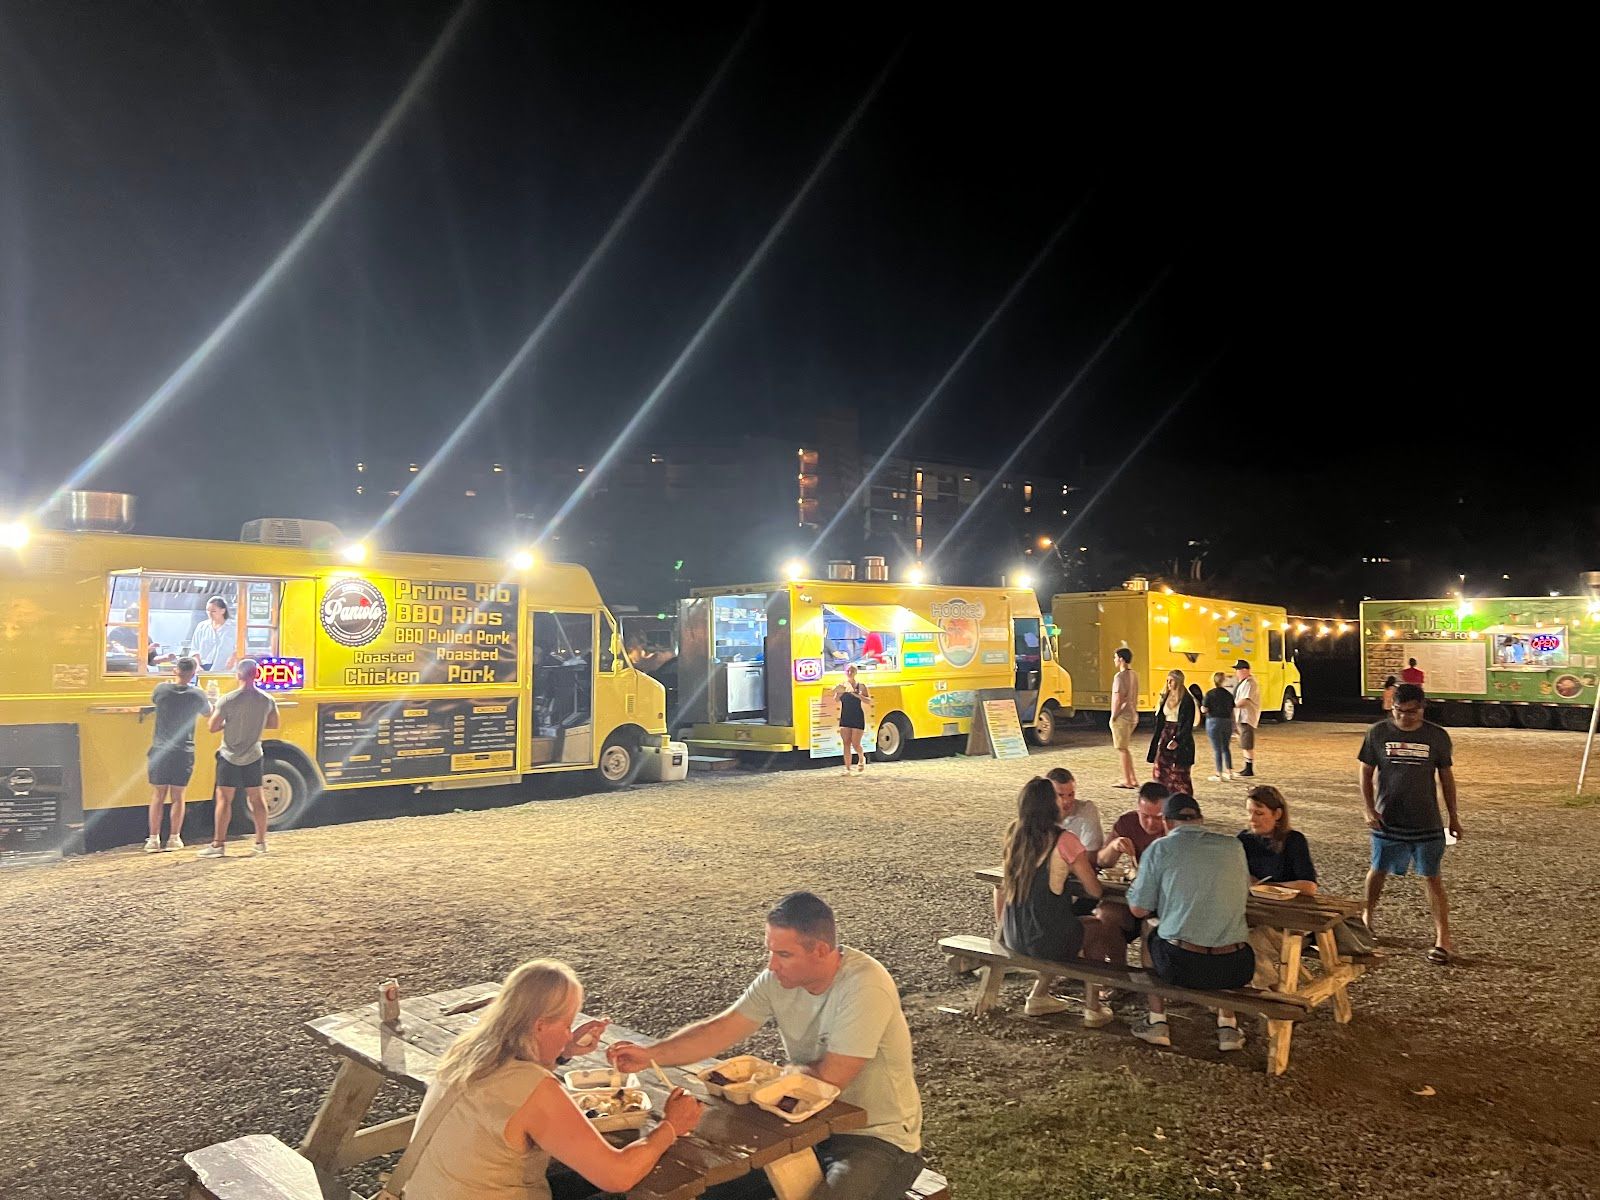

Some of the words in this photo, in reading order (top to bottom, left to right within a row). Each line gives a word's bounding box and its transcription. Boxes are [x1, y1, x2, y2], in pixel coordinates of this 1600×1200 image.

[395, 579, 467, 601] Prime
[324, 597, 383, 625] Paniolo
[395, 604, 445, 626] BBQ
[452, 607, 503, 626] Ribs
[395, 628, 424, 645] BBQ
[428, 630, 473, 645] Pulled
[476, 631, 511, 646] Pork
[1533, 638, 1556, 647] OPEN
[354, 651, 415, 664] Roasted
[437, 648, 499, 662] Roasted
[255, 664, 298, 683] OPEN
[344, 667, 420, 685] Chicken
[448, 665, 495, 683] Pork
